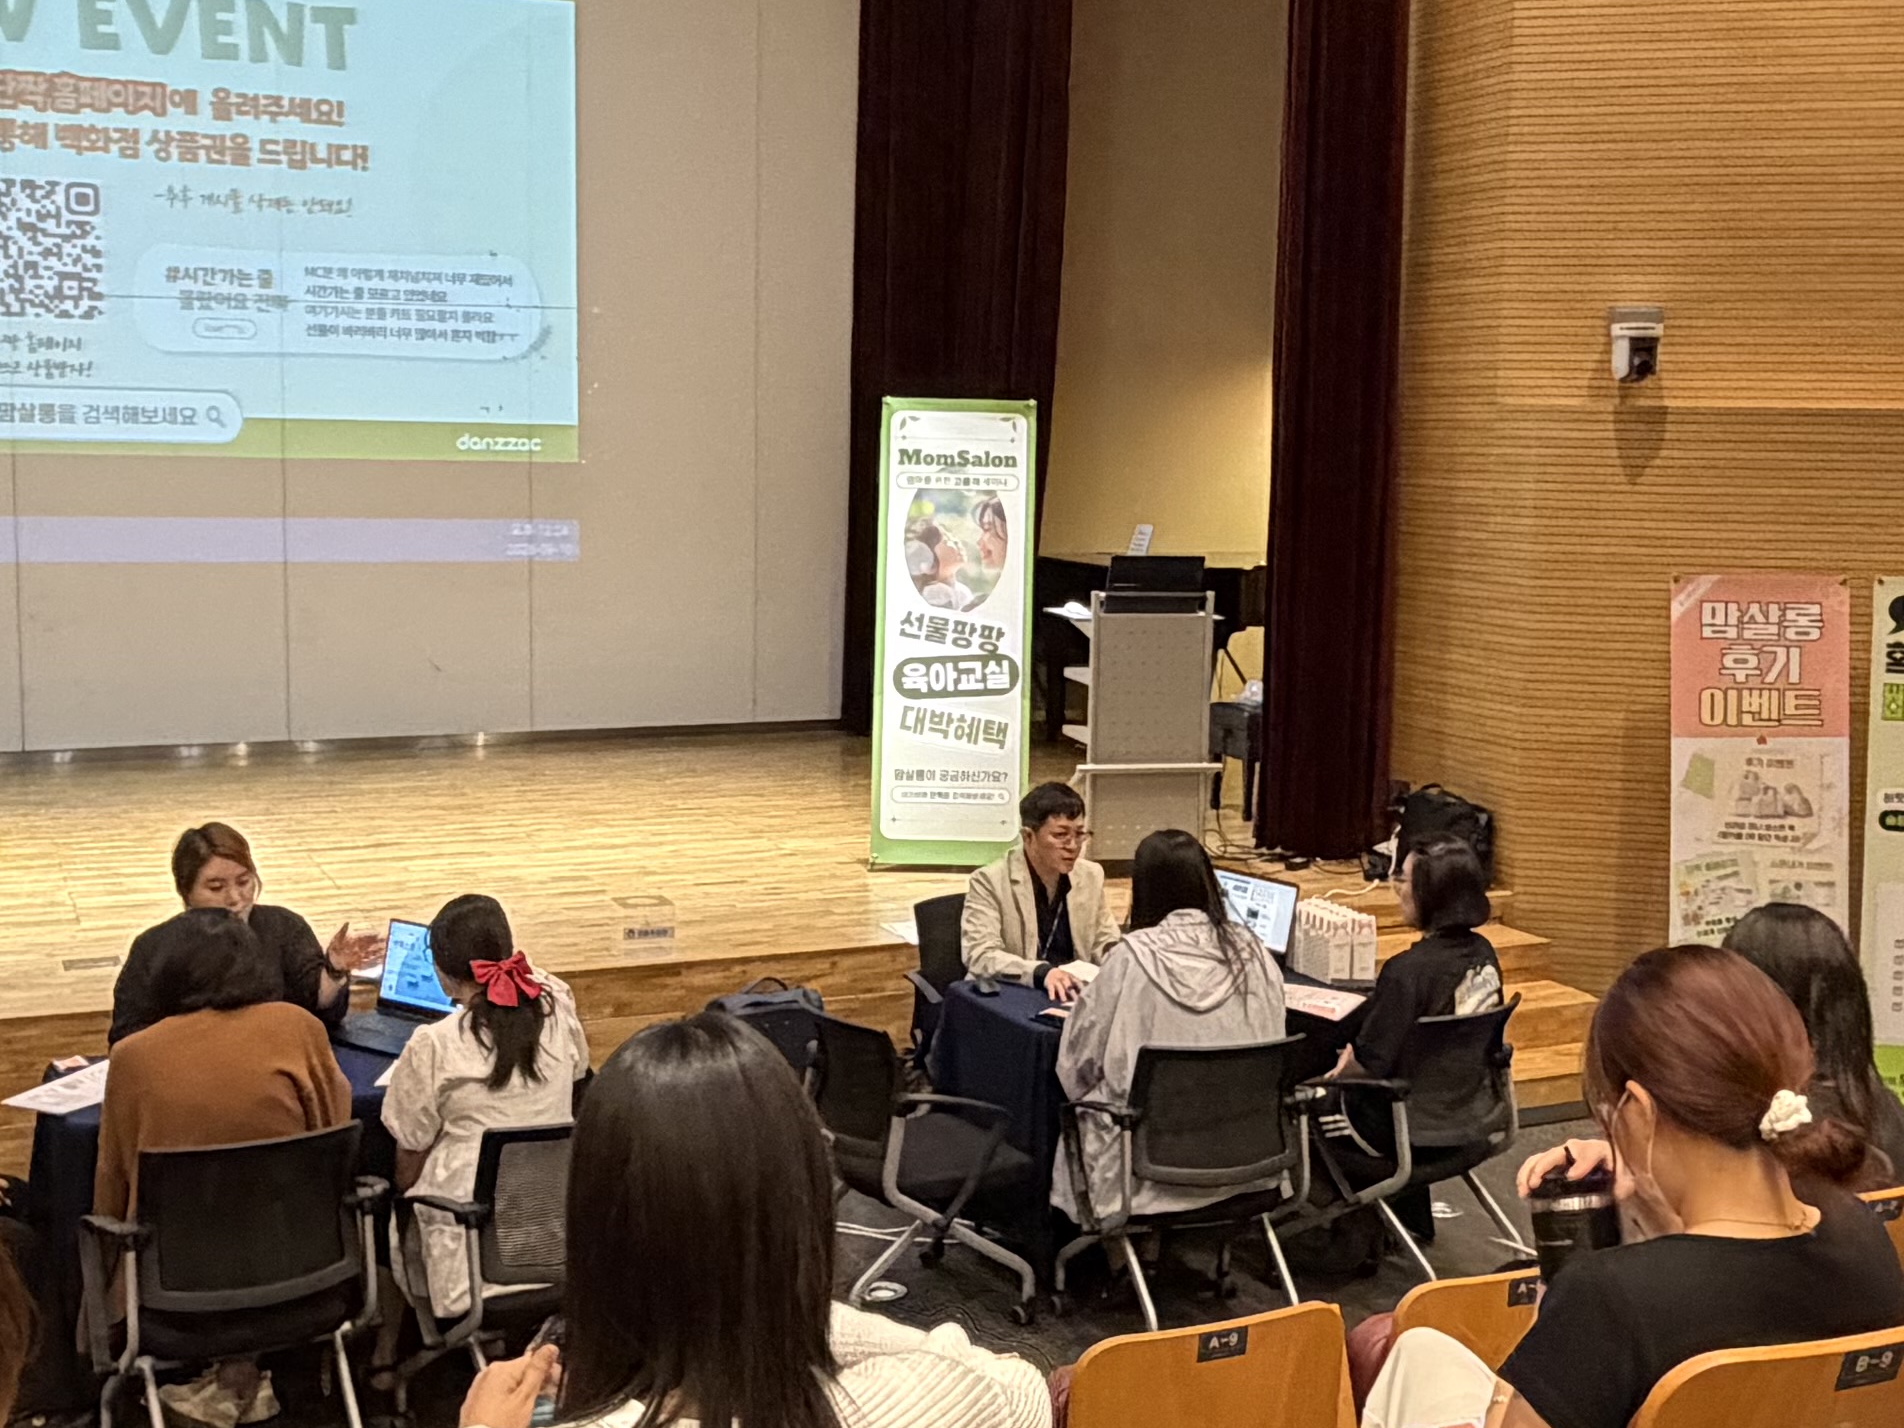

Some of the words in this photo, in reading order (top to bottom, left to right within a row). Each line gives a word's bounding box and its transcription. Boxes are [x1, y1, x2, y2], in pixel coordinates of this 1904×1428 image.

[209, 87, 345, 127] 올려주세요!
[55, 123, 141, 160] 백화점
[147, 129, 251, 167] 상품권을
[256, 137, 370, 172] 드립니다!
[83, 404, 197, 427] 검색해보세요
[456, 433, 542, 452] danzzac
[898, 448, 1017, 468] MomSalon
[900, 610, 1005, 655] 선물팡팡
[1701, 600, 1824, 641] 맘살롱
[901, 660, 1011, 693] 육아교실
[1719, 644, 1801, 684] 후기
[1698, 687, 1824, 727] 이벤트
[900, 705, 1009, 750] 대박혜택
[939, 770, 1008, 782] 궁금하신가요?
[1208, 1332, 1239, 1350] A-9
[1855, 1352, 1893, 1374] B-9
